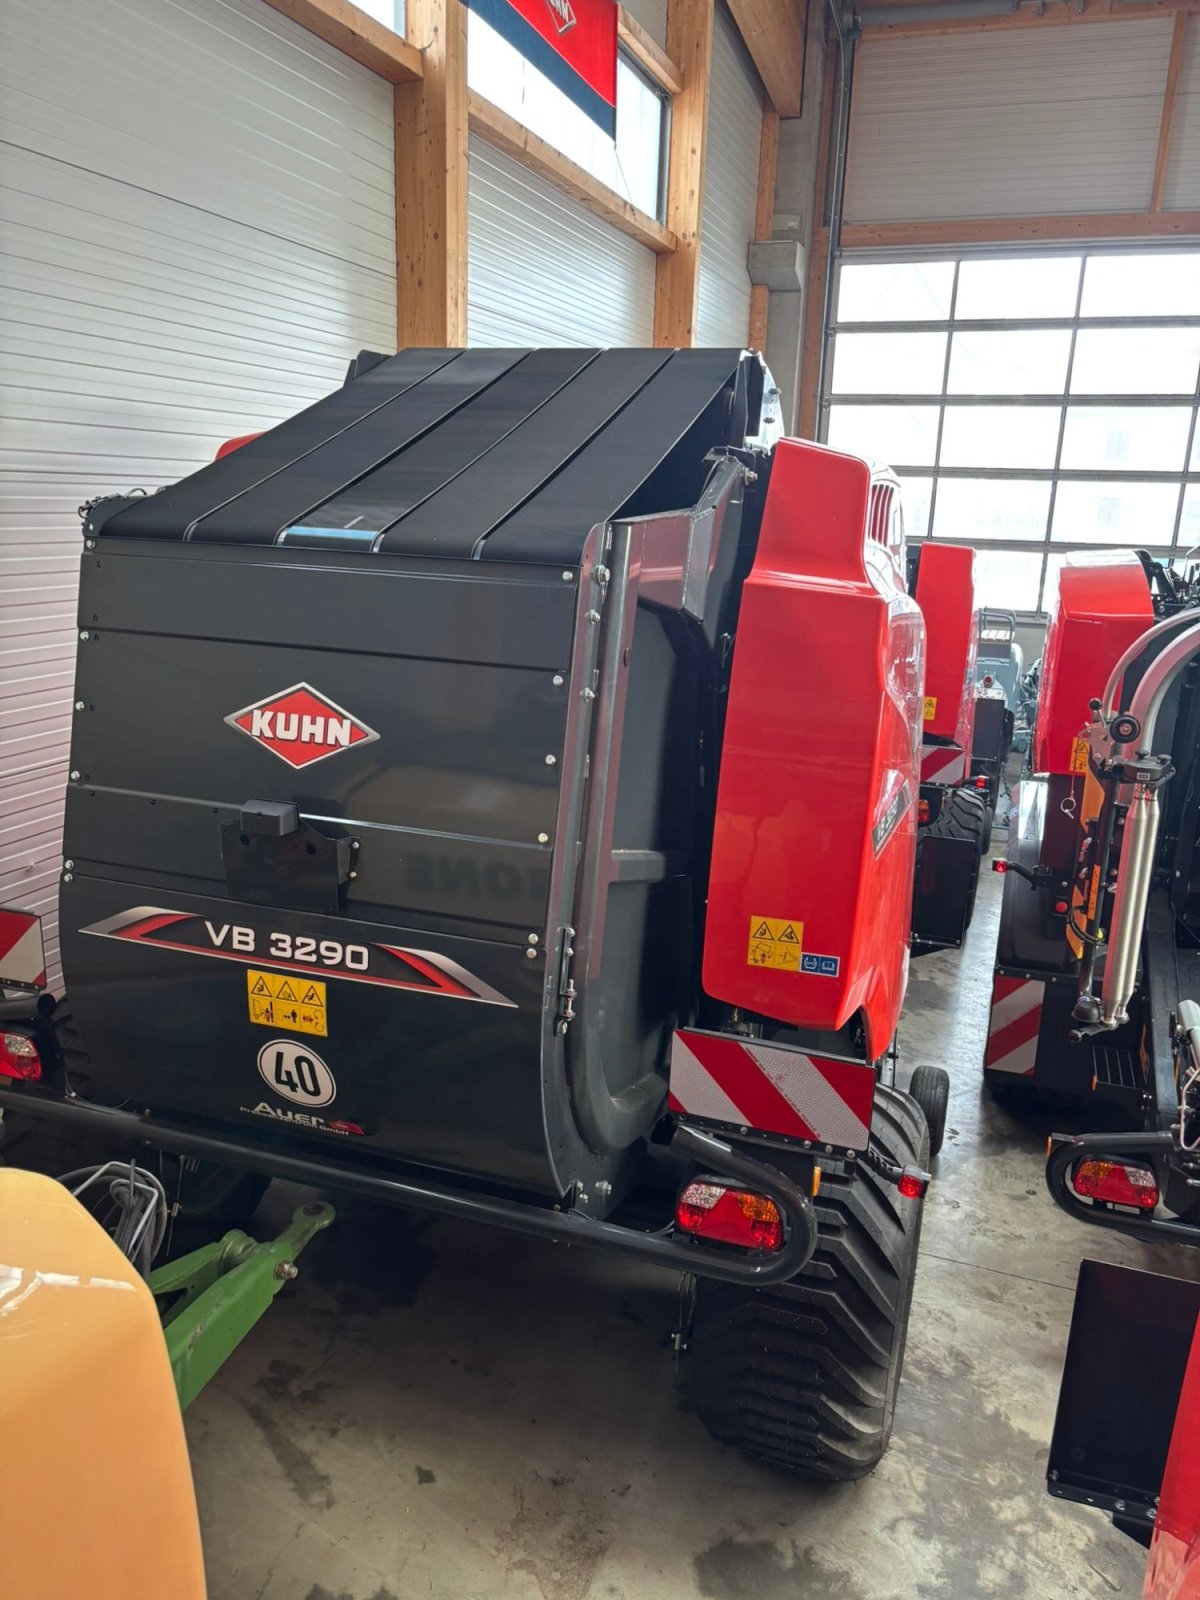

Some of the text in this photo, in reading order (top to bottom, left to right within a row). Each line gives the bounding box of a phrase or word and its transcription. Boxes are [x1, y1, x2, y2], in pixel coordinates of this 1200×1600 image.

[251, 709, 352, 747] KUHN
[204, 920, 369, 971] VB 3290
[275, 1051, 321, 1097] 40
